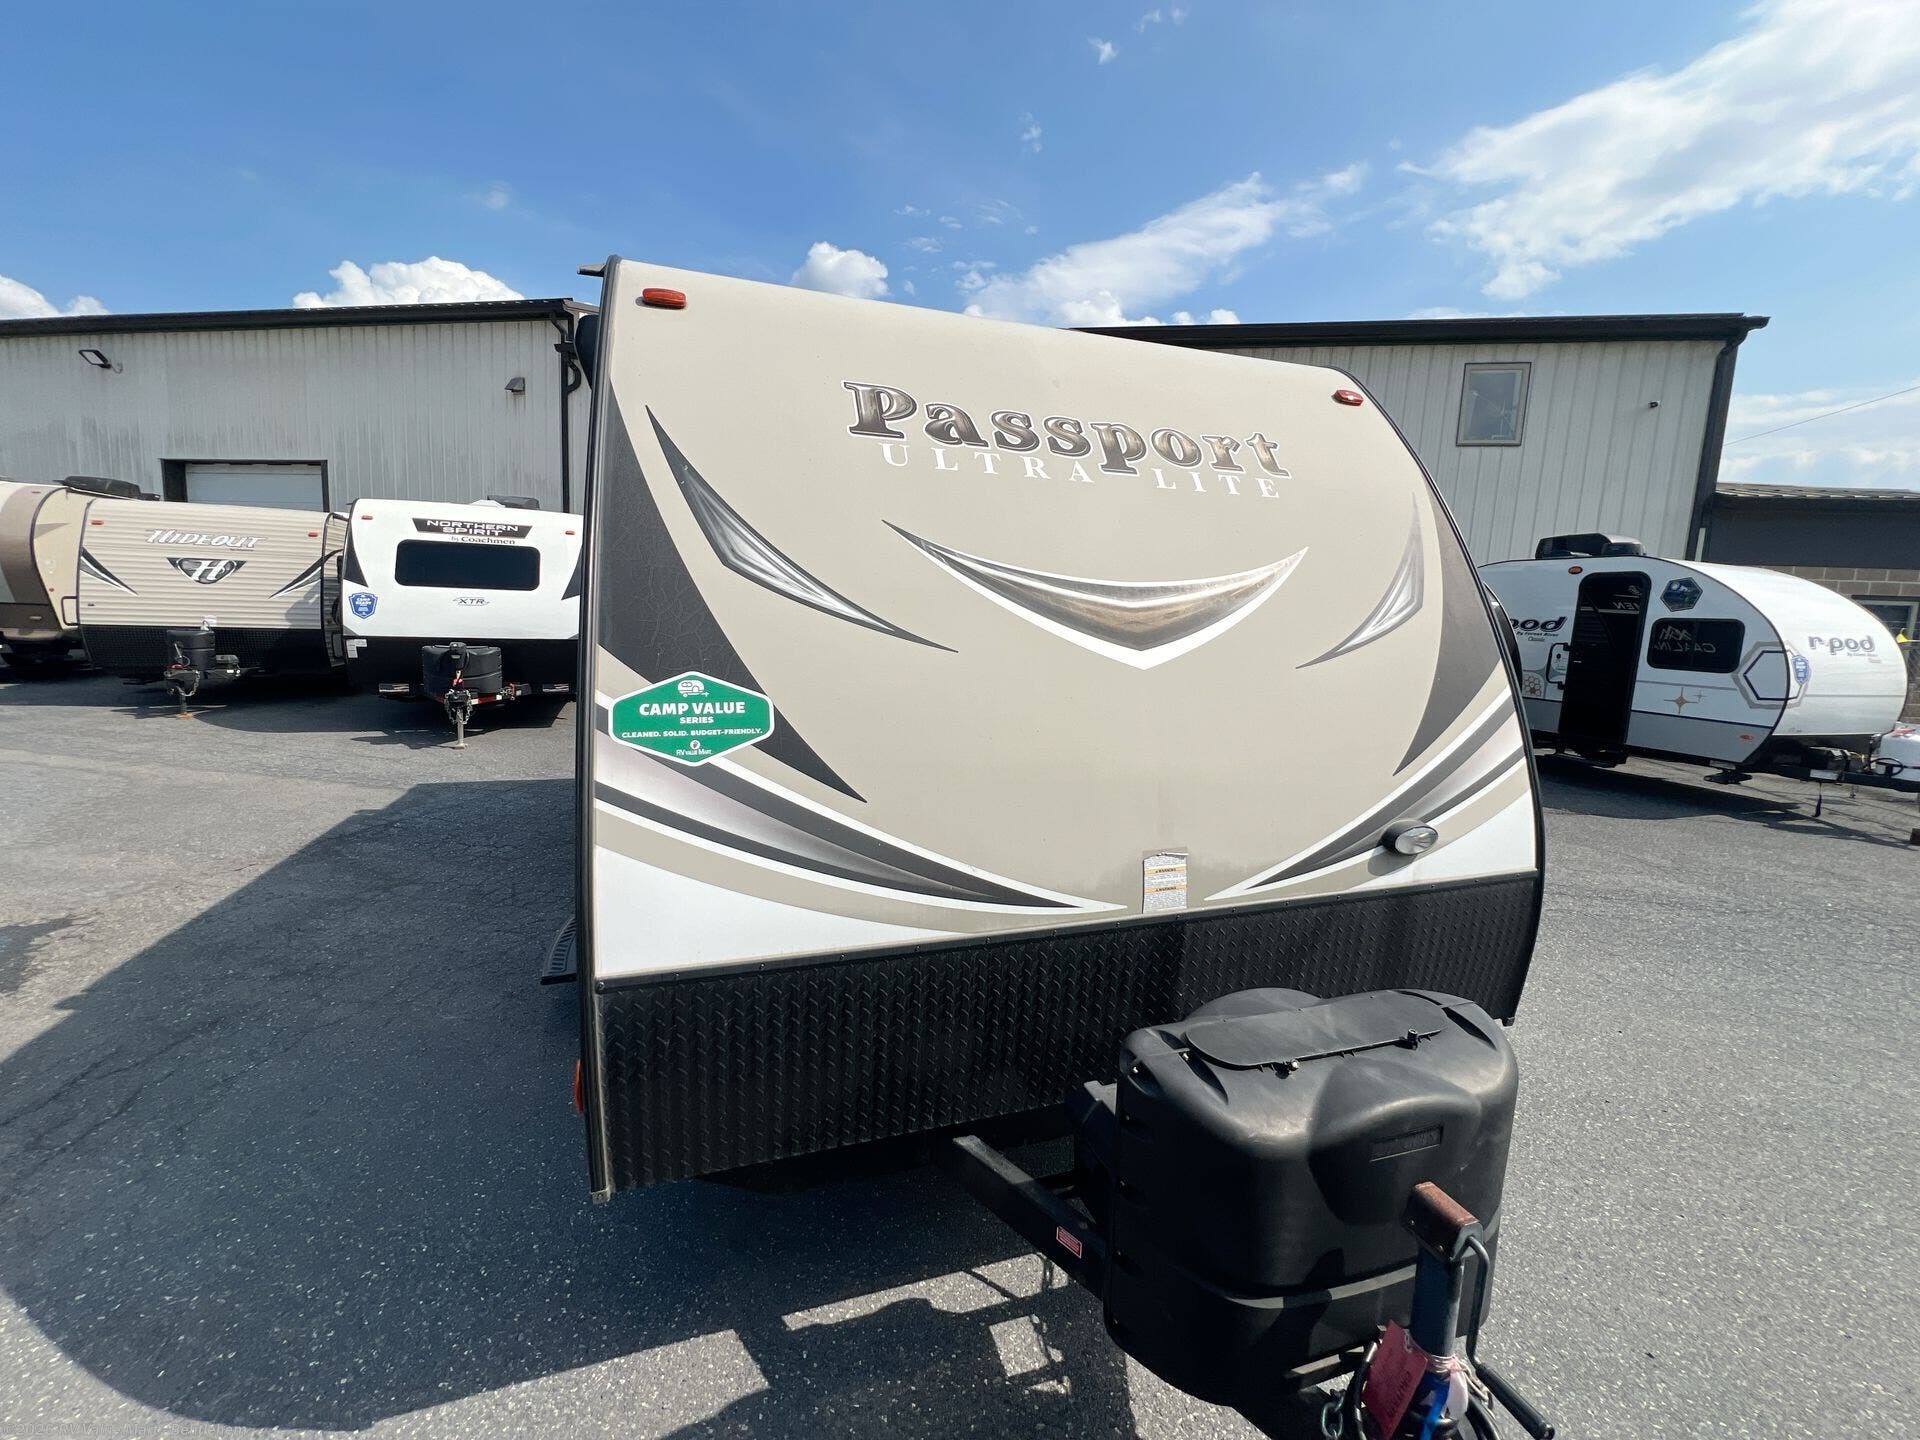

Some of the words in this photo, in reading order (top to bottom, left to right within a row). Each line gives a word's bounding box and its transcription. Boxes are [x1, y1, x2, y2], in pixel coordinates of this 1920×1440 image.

[842, 380, 1292, 479] Passport
[878, 442, 1095, 484] ULTRA
[1150, 467, 1281, 499] LITE
[426, 519, 519, 532] NORTHERN
[442, 526, 503, 536] SPIRIT
[461, 536, 515, 545] Coachmen
[639, 702, 689, 716] CAMP
[692, 701, 746, 714] VALUE
[679, 716, 714, 724] SERIES
[690, 728, 763, 736] BUDGET-FRIENDLY.
